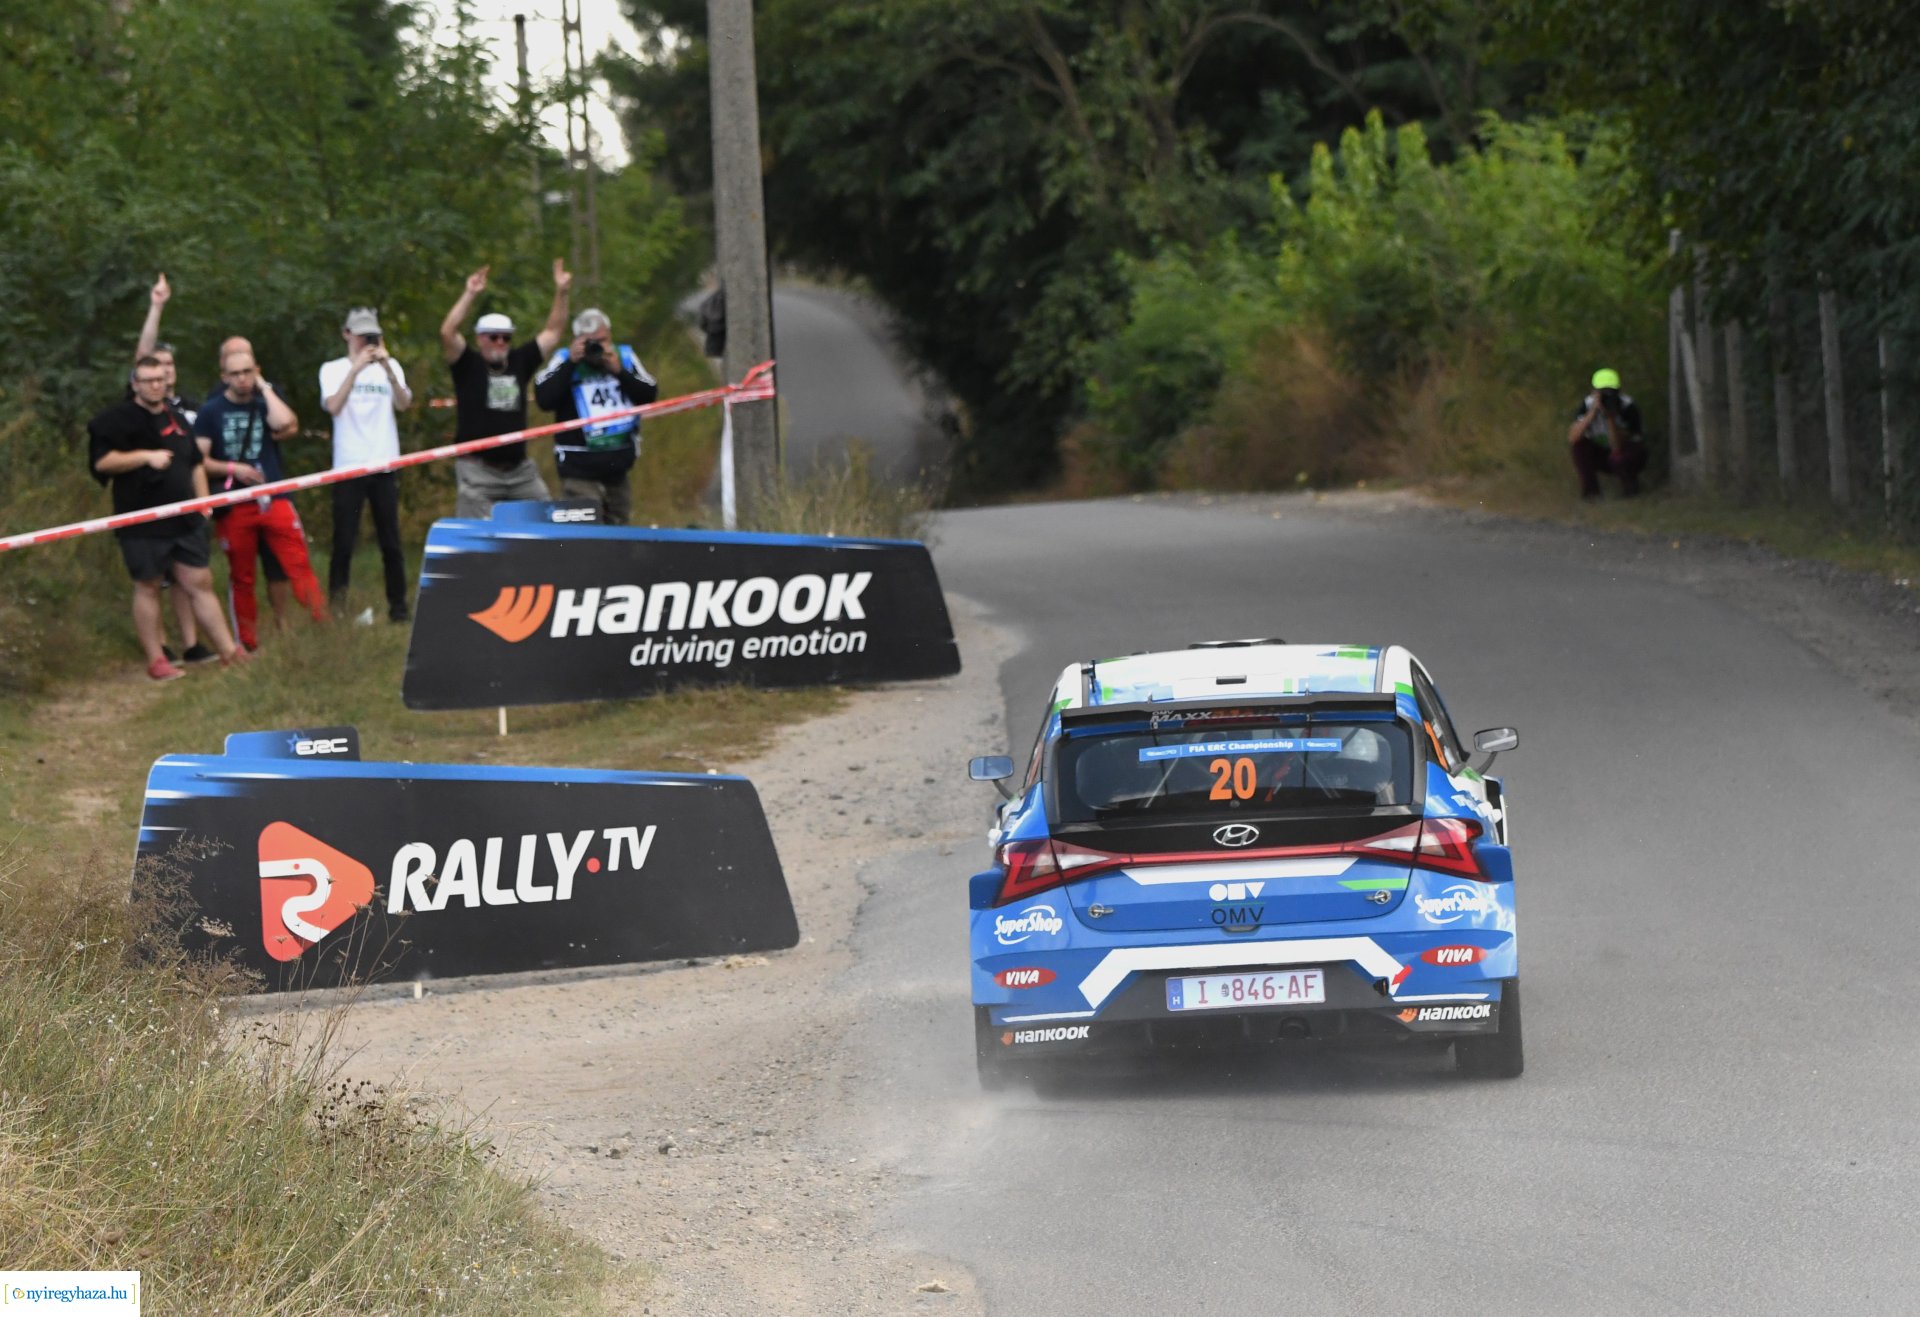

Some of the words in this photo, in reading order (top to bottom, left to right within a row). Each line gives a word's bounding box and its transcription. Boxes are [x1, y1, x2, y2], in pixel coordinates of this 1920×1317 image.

[629, 635, 735, 668] driving
[746, 627, 867, 660] emotion
[1189, 744, 1206, 754] FIA
[1208, 743, 1227, 752] ERC
[1228, 740, 1294, 753] Championship
[1209, 757, 1257, 801] 20
[994, 912, 1063, 937] SuperShop
[1211, 906, 1265, 925] OMV
[1436, 948, 1473, 963] VIVA
[1005, 969, 1040, 986] VIVA
[1231, 974, 1318, 1002] 846-AF
[1172, 996, 1181, 1005] H
